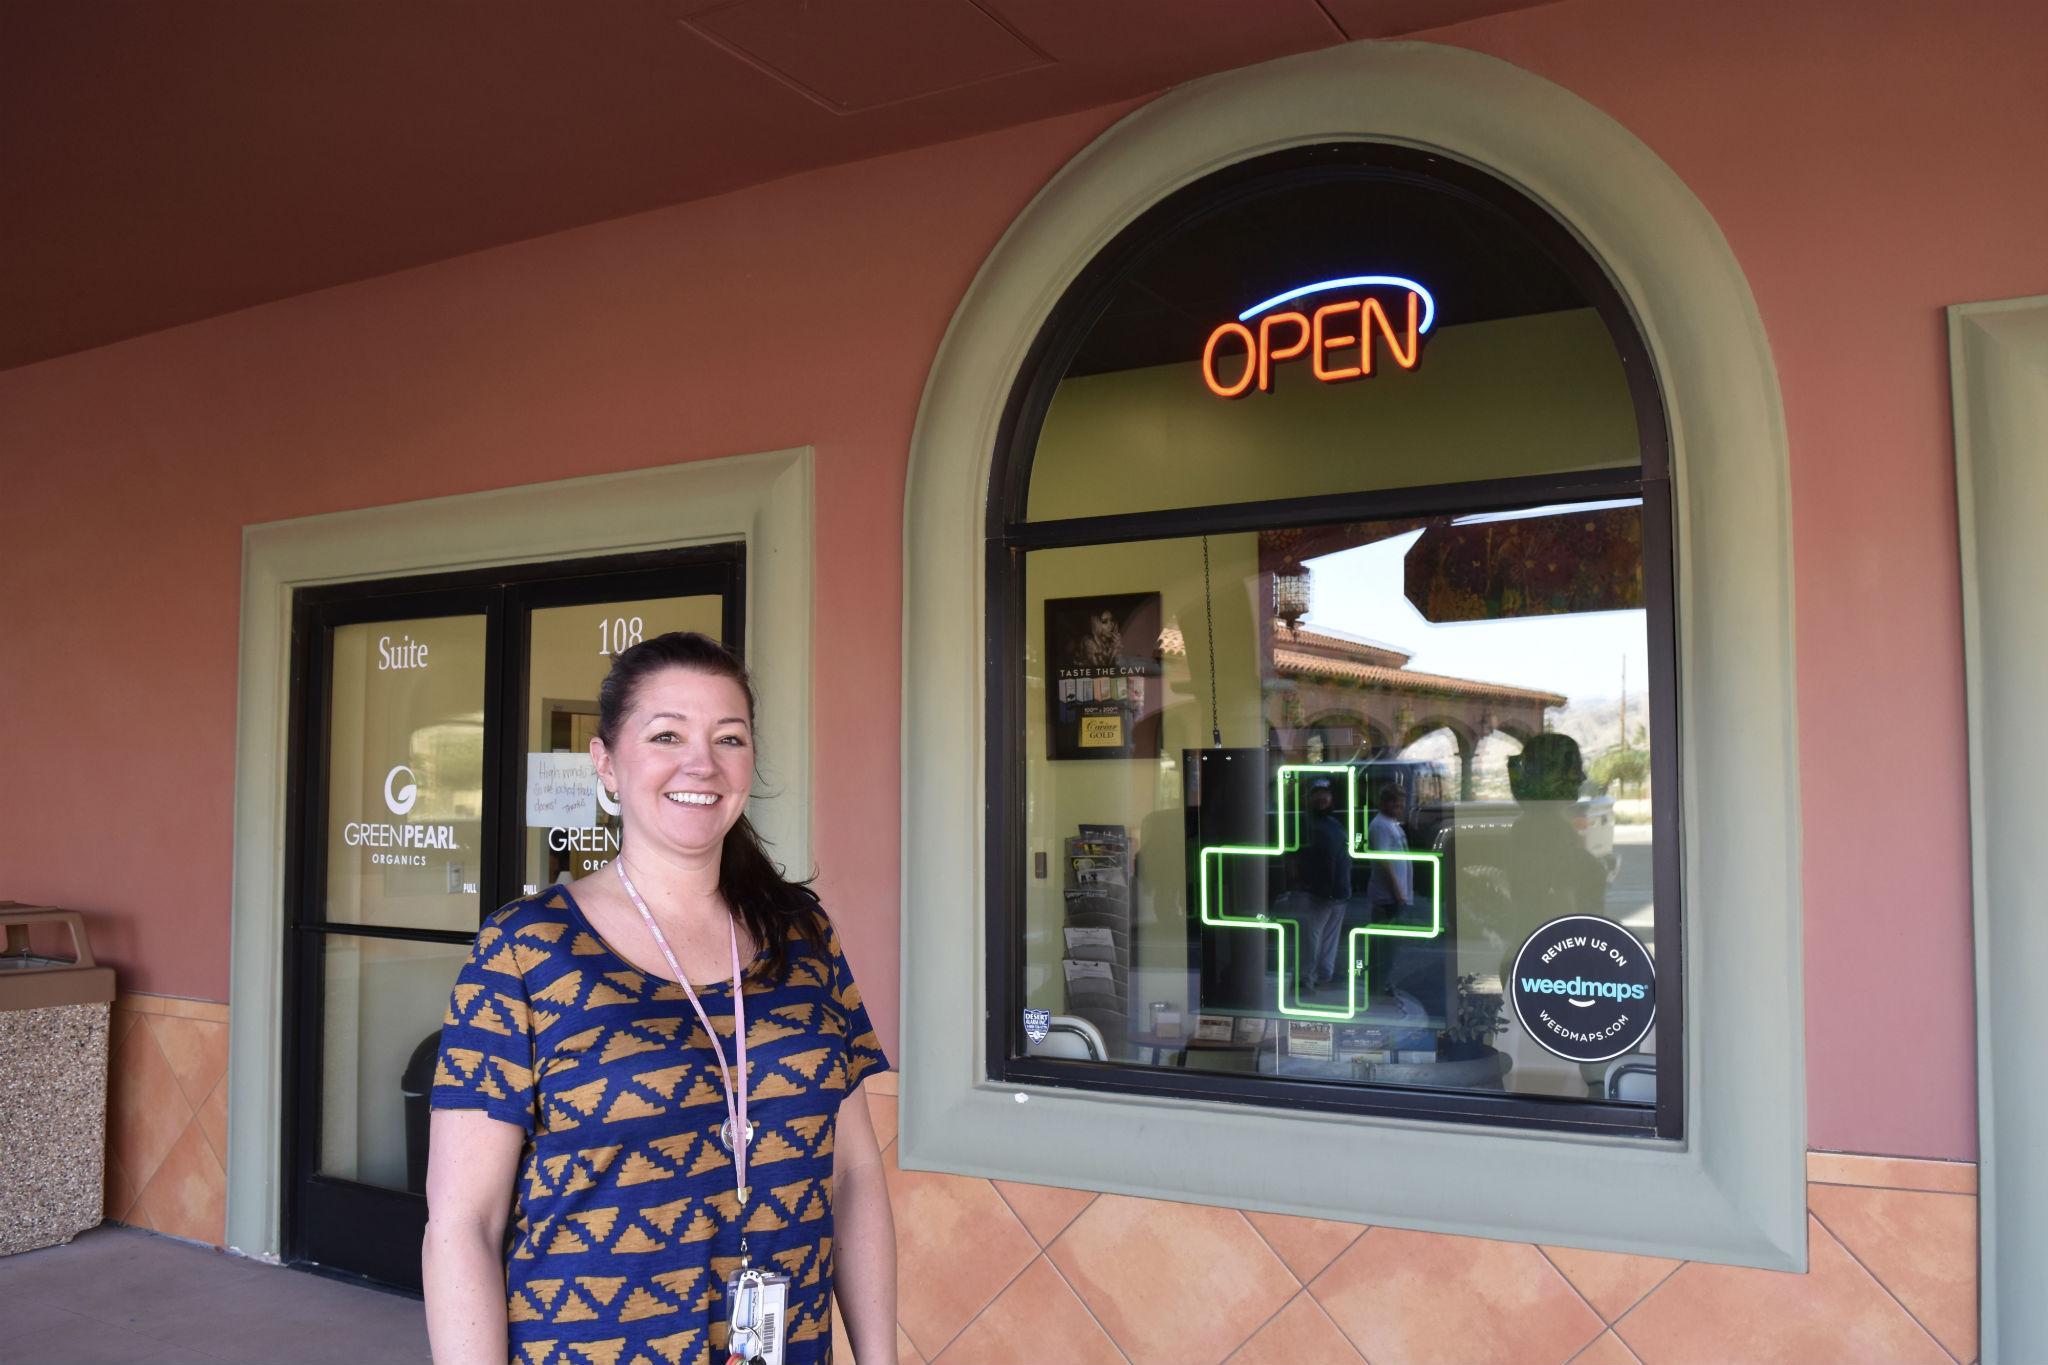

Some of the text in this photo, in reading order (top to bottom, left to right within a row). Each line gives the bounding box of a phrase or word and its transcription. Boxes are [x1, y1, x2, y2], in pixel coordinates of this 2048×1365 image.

[1202, 291, 1418, 398] OPEN
[378, 616, 643, 670] Suite 108
[1059, 666, 1145, 678] TASTE THE CAVI
[371, 853, 426, 866] ORGANICS
[463, 883, 477, 894] PULL
[523, 884, 537, 895] PULL
[1541, 937, 1627, 967] REVIEW US ON
[1521, 976, 1645, 1002] weedmaps
[1539, 1009, 1629, 1043] WEEDMAPS.COM
